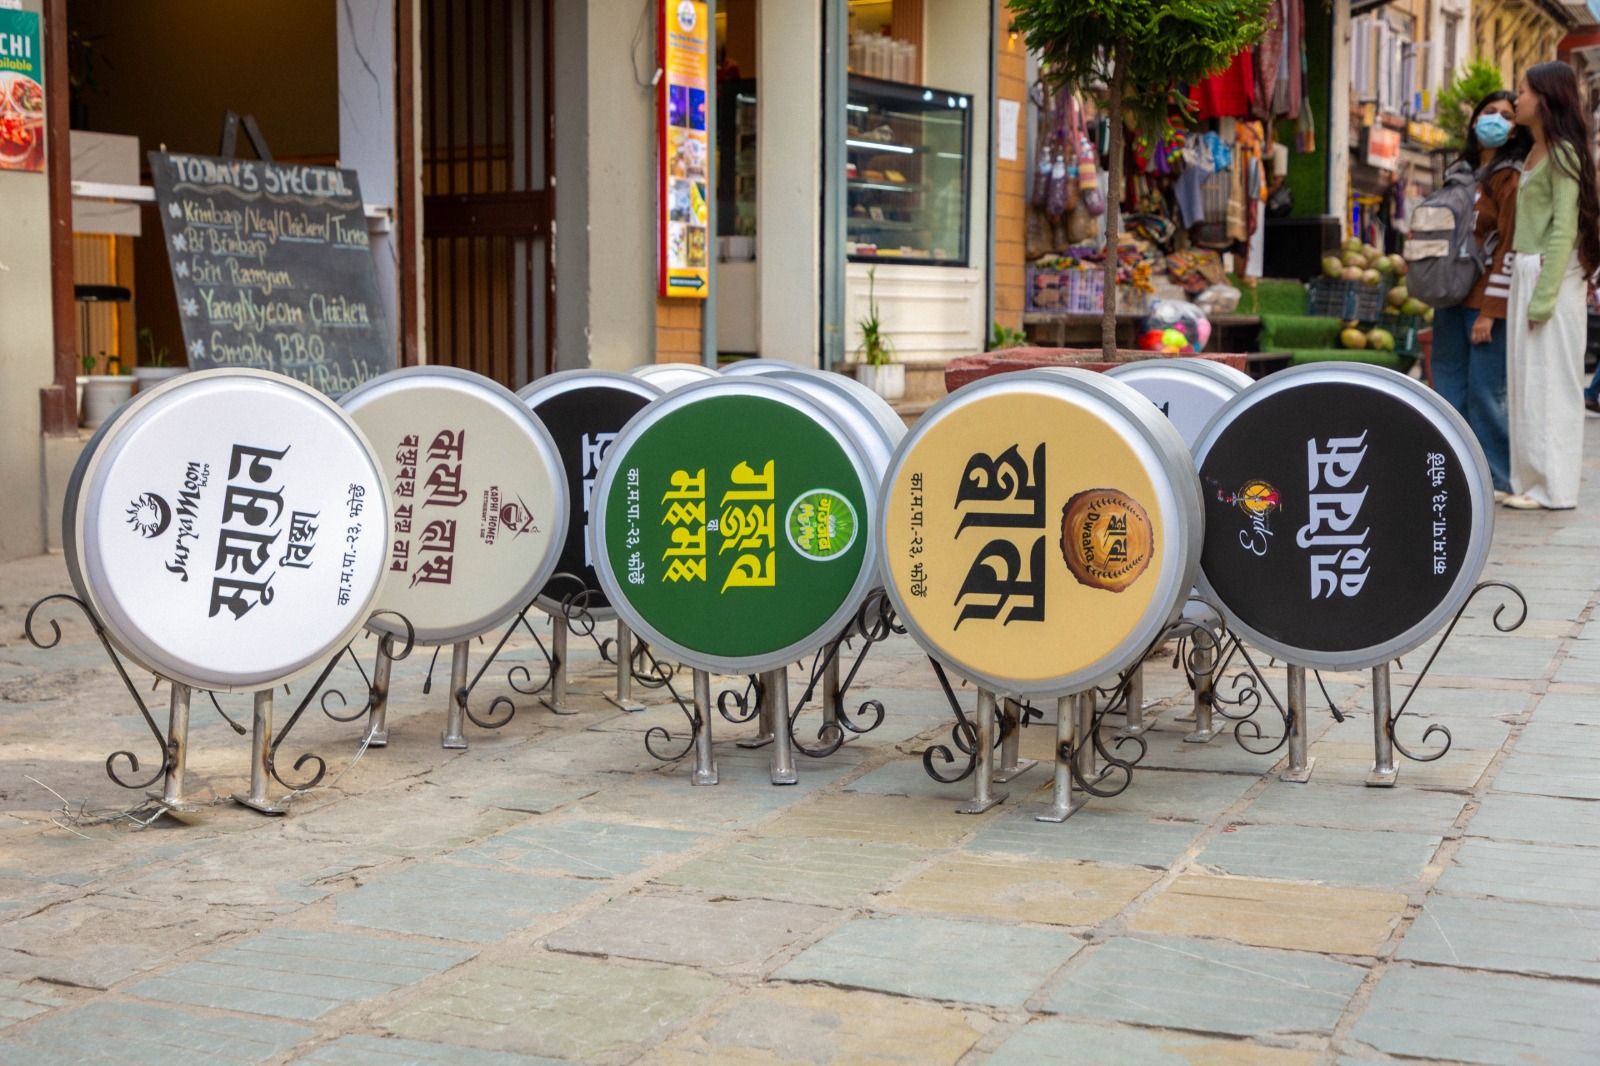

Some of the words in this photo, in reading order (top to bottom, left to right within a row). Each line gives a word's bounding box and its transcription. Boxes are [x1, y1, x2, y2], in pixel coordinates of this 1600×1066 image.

[169, 155, 259, 192] TODAY'S
[264, 164, 353, 197] SPECIAL
[206, 228, 267, 264] Bimbap
[192, 254, 223, 282] Sin
[225, 256, 292, 295] Ramyun
[310, 293, 369, 324] Chicken
[211, 330, 274, 369] Smoky
[275, 332, 326, 362] BBQ
[198, 463, 210, 487] bistro
[489, 485, 499, 512] KAPHI
[485, 516, 498, 545] HOMES
[1082, 512, 1101, 564] Dwaaka
[1239, 505, 1274, 556] Epic
